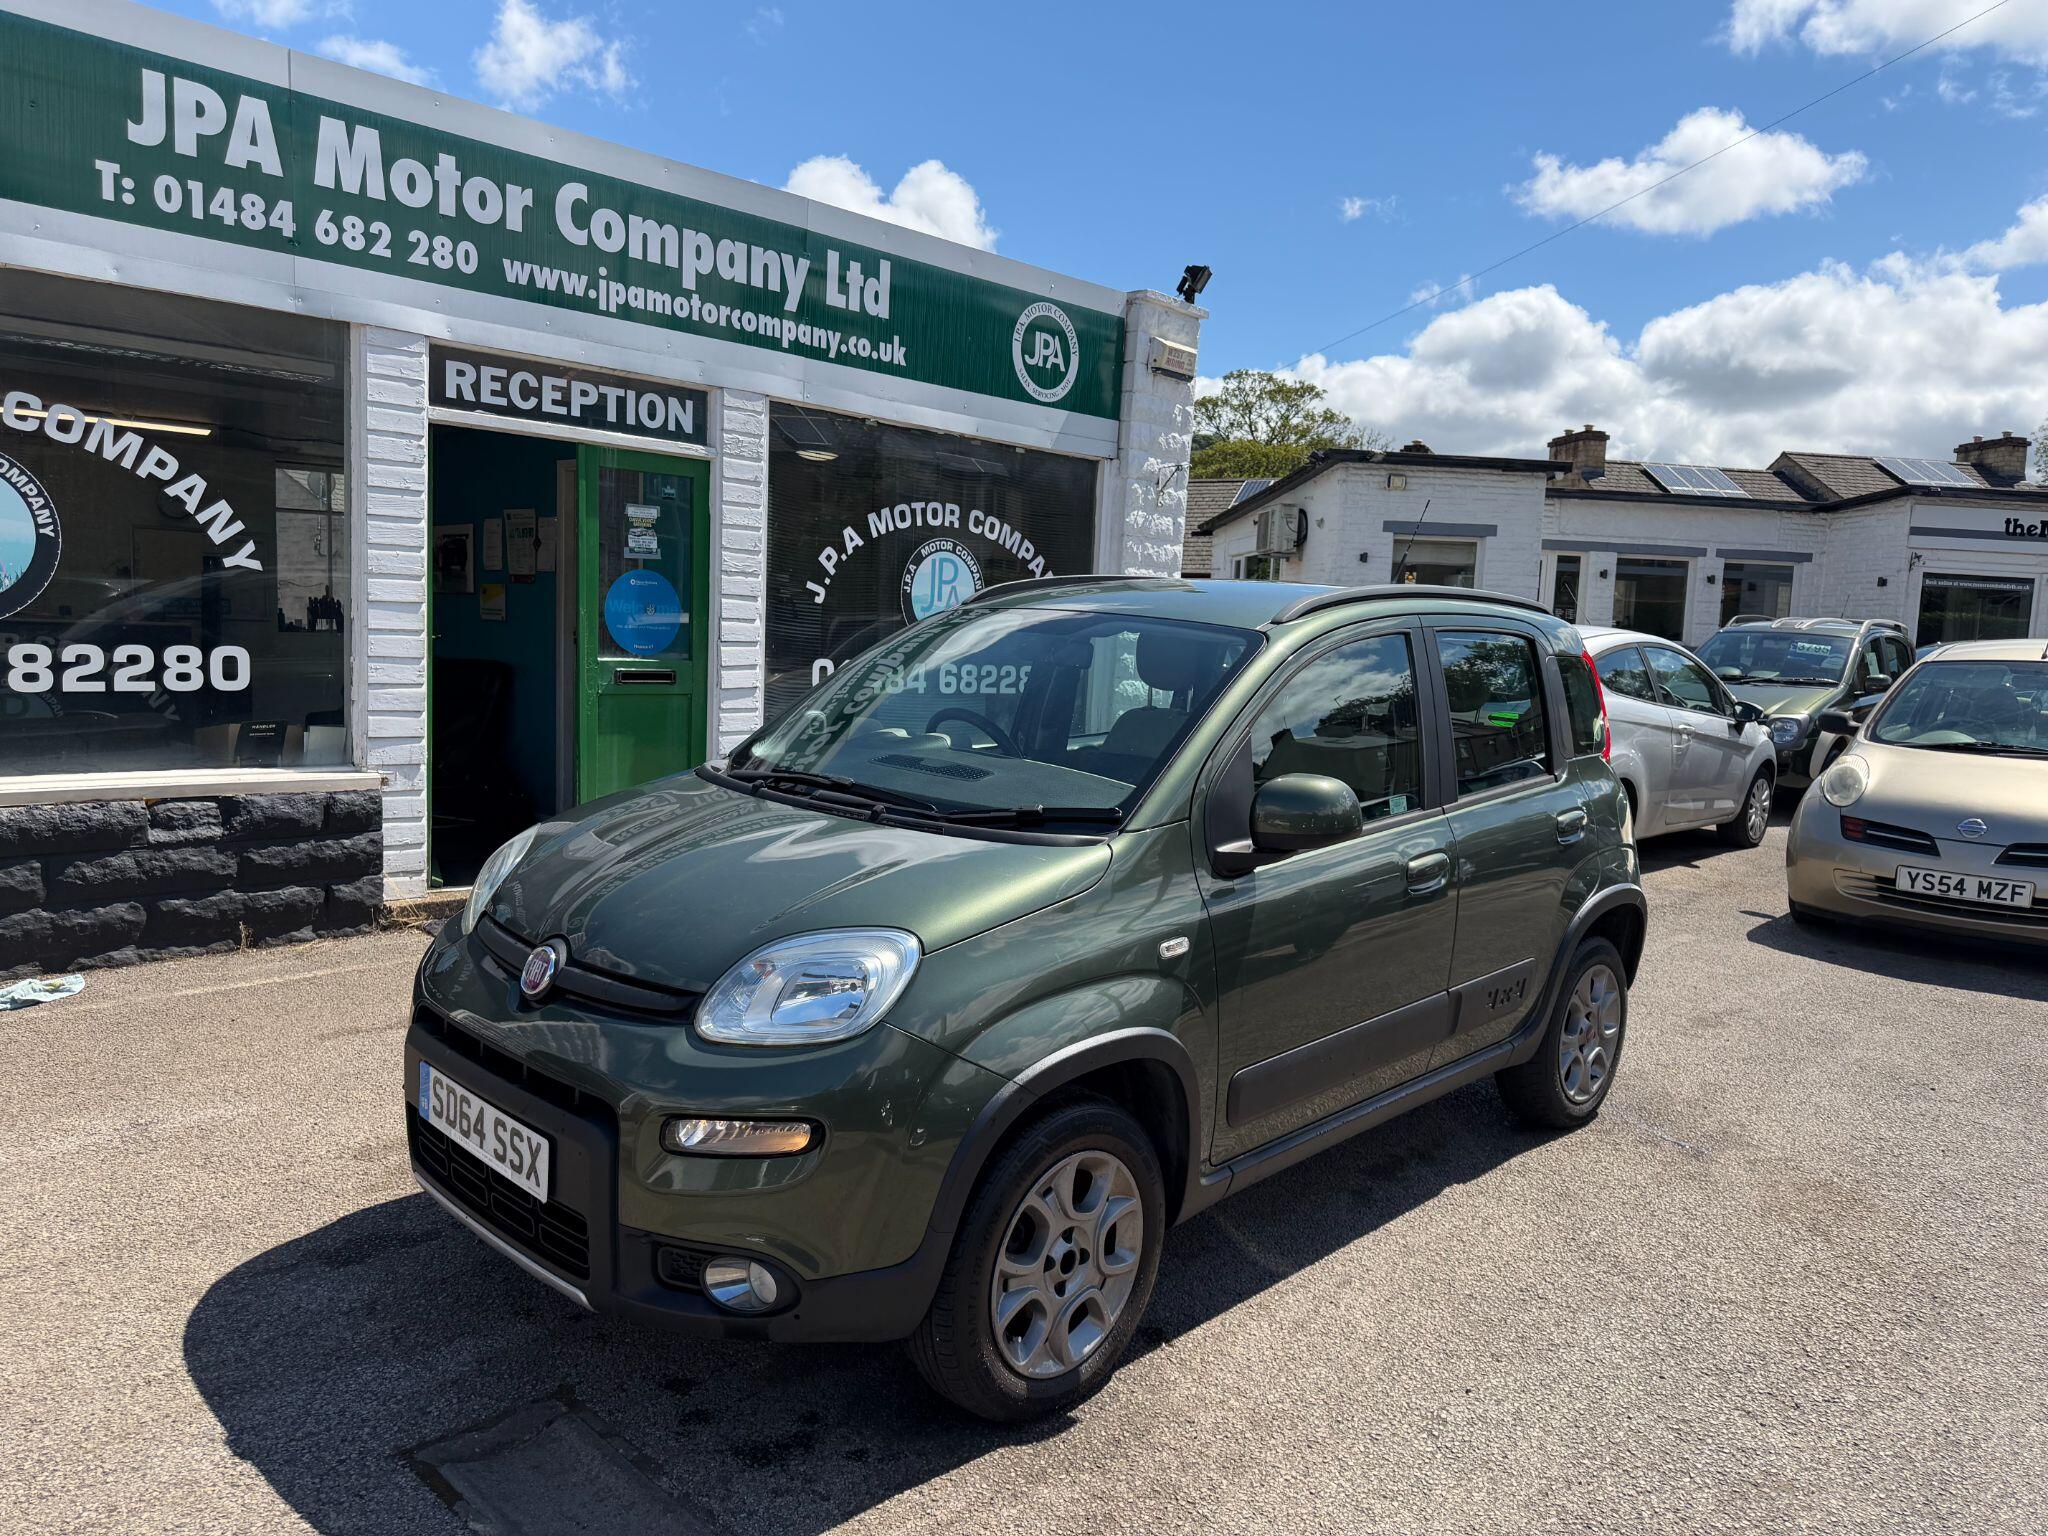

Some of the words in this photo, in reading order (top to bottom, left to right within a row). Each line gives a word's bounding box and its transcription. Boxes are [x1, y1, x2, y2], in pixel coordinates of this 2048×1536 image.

[127, 68, 284, 177] JPA
[314, 116, 533, 232] Motor
[555, 182, 810, 312] Company
[826, 249, 891, 319] Ltd
[95, 159, 135, 205] T:
[154, 174, 296, 237] 01484
[315, 209, 392, 258] 682
[408, 230, 478, 274] 280
[502, 257, 906, 367] www.jpamotorcompany.co.uk
[1024, 303, 1053, 320] MOTOR
[1054, 308, 1078, 356] COMPANY
[1024, 331, 1065, 372] JPA
[445, 359, 694, 435] RECEPTION
[2, 390, 264, 572] COMPANY
[805, 525, 865, 604] J.P.A
[867, 501, 961, 538] MOTOR
[968, 509, 1055, 578] COMPA
[903, 564, 917, 593] J.P.A
[920, 540, 953, 557] MOTOR
[7, 643, 251, 693] 82280
[1907, 871, 1967, 896] YS54
[1977, 880, 2027, 903] MZF
[526, 958, 549, 984] FIAT
[432, 1075, 487, 1150] SD64
[493, 1116, 542, 1188] SSX
